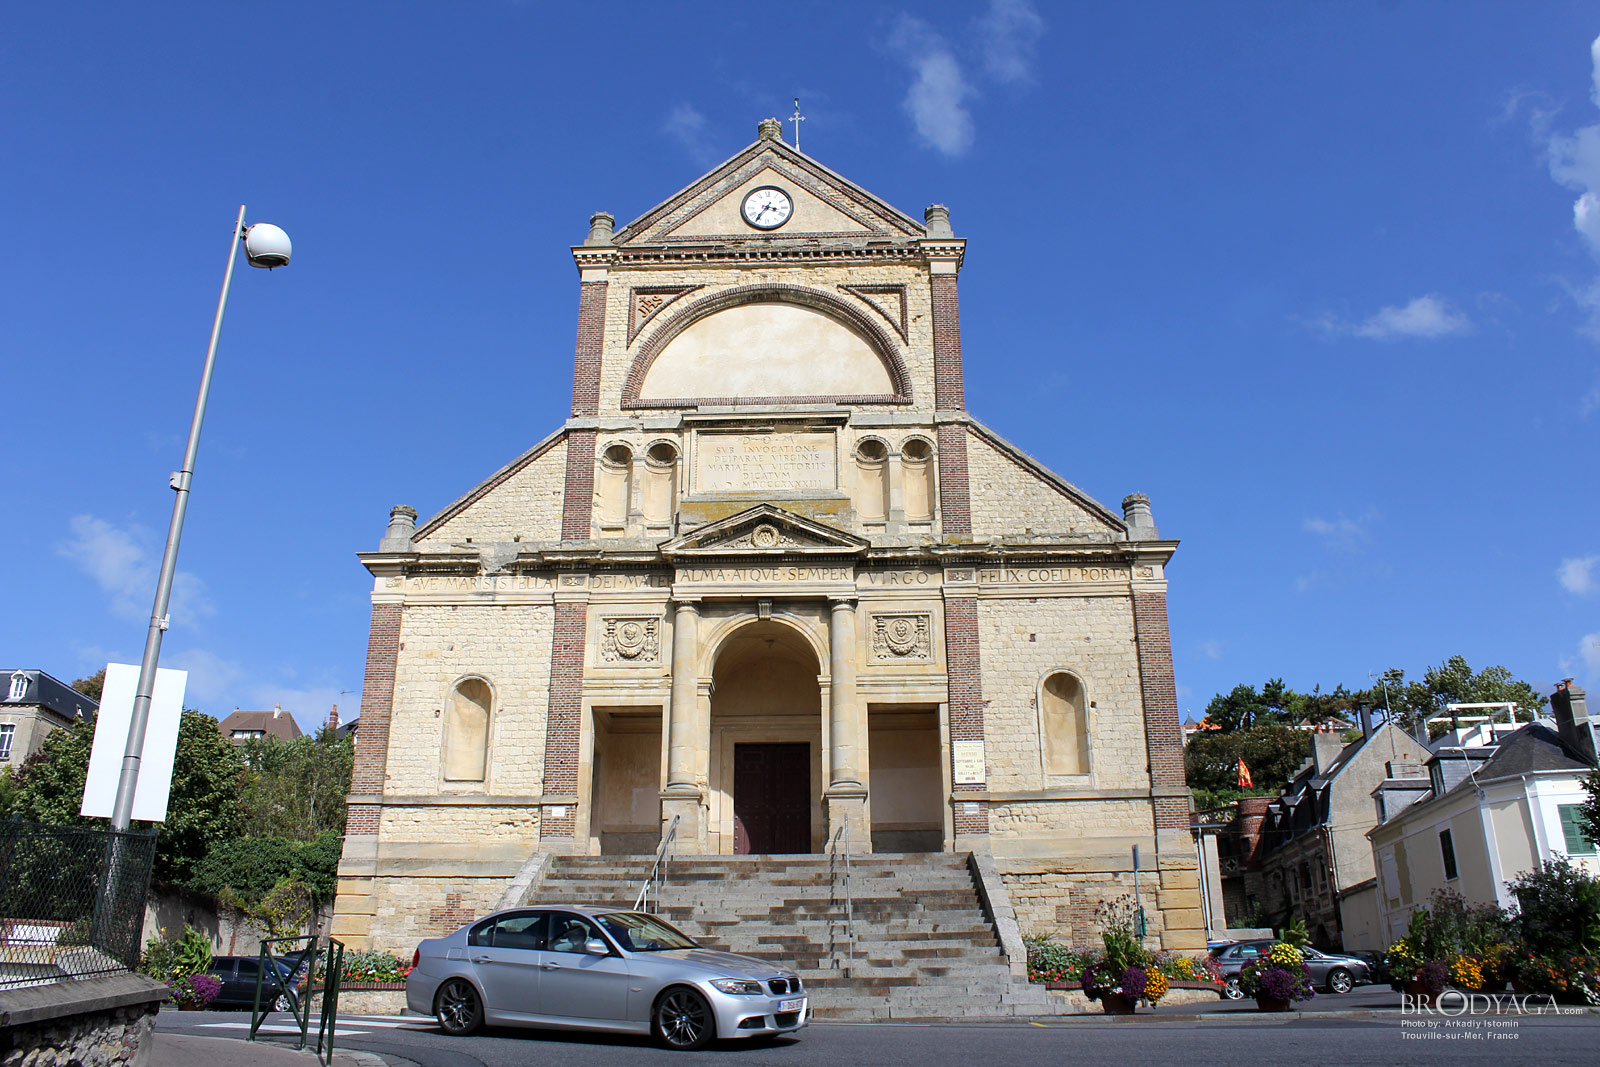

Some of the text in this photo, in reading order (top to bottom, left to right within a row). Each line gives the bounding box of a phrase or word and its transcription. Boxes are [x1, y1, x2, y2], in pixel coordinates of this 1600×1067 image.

[744, 445, 818, 453] INVOCATIONE
[771, 454, 820, 462] VIRGINIS
[707, 464, 748, 472] MARIAE
[743, 472, 791, 480] DICATVM
[788, 567, 849, 581] SEMPER
[866, 571, 929, 585] VIRGO
[1080, 568, 1127, 581] PORTA
[499, 577, 553, 590] STELLA
